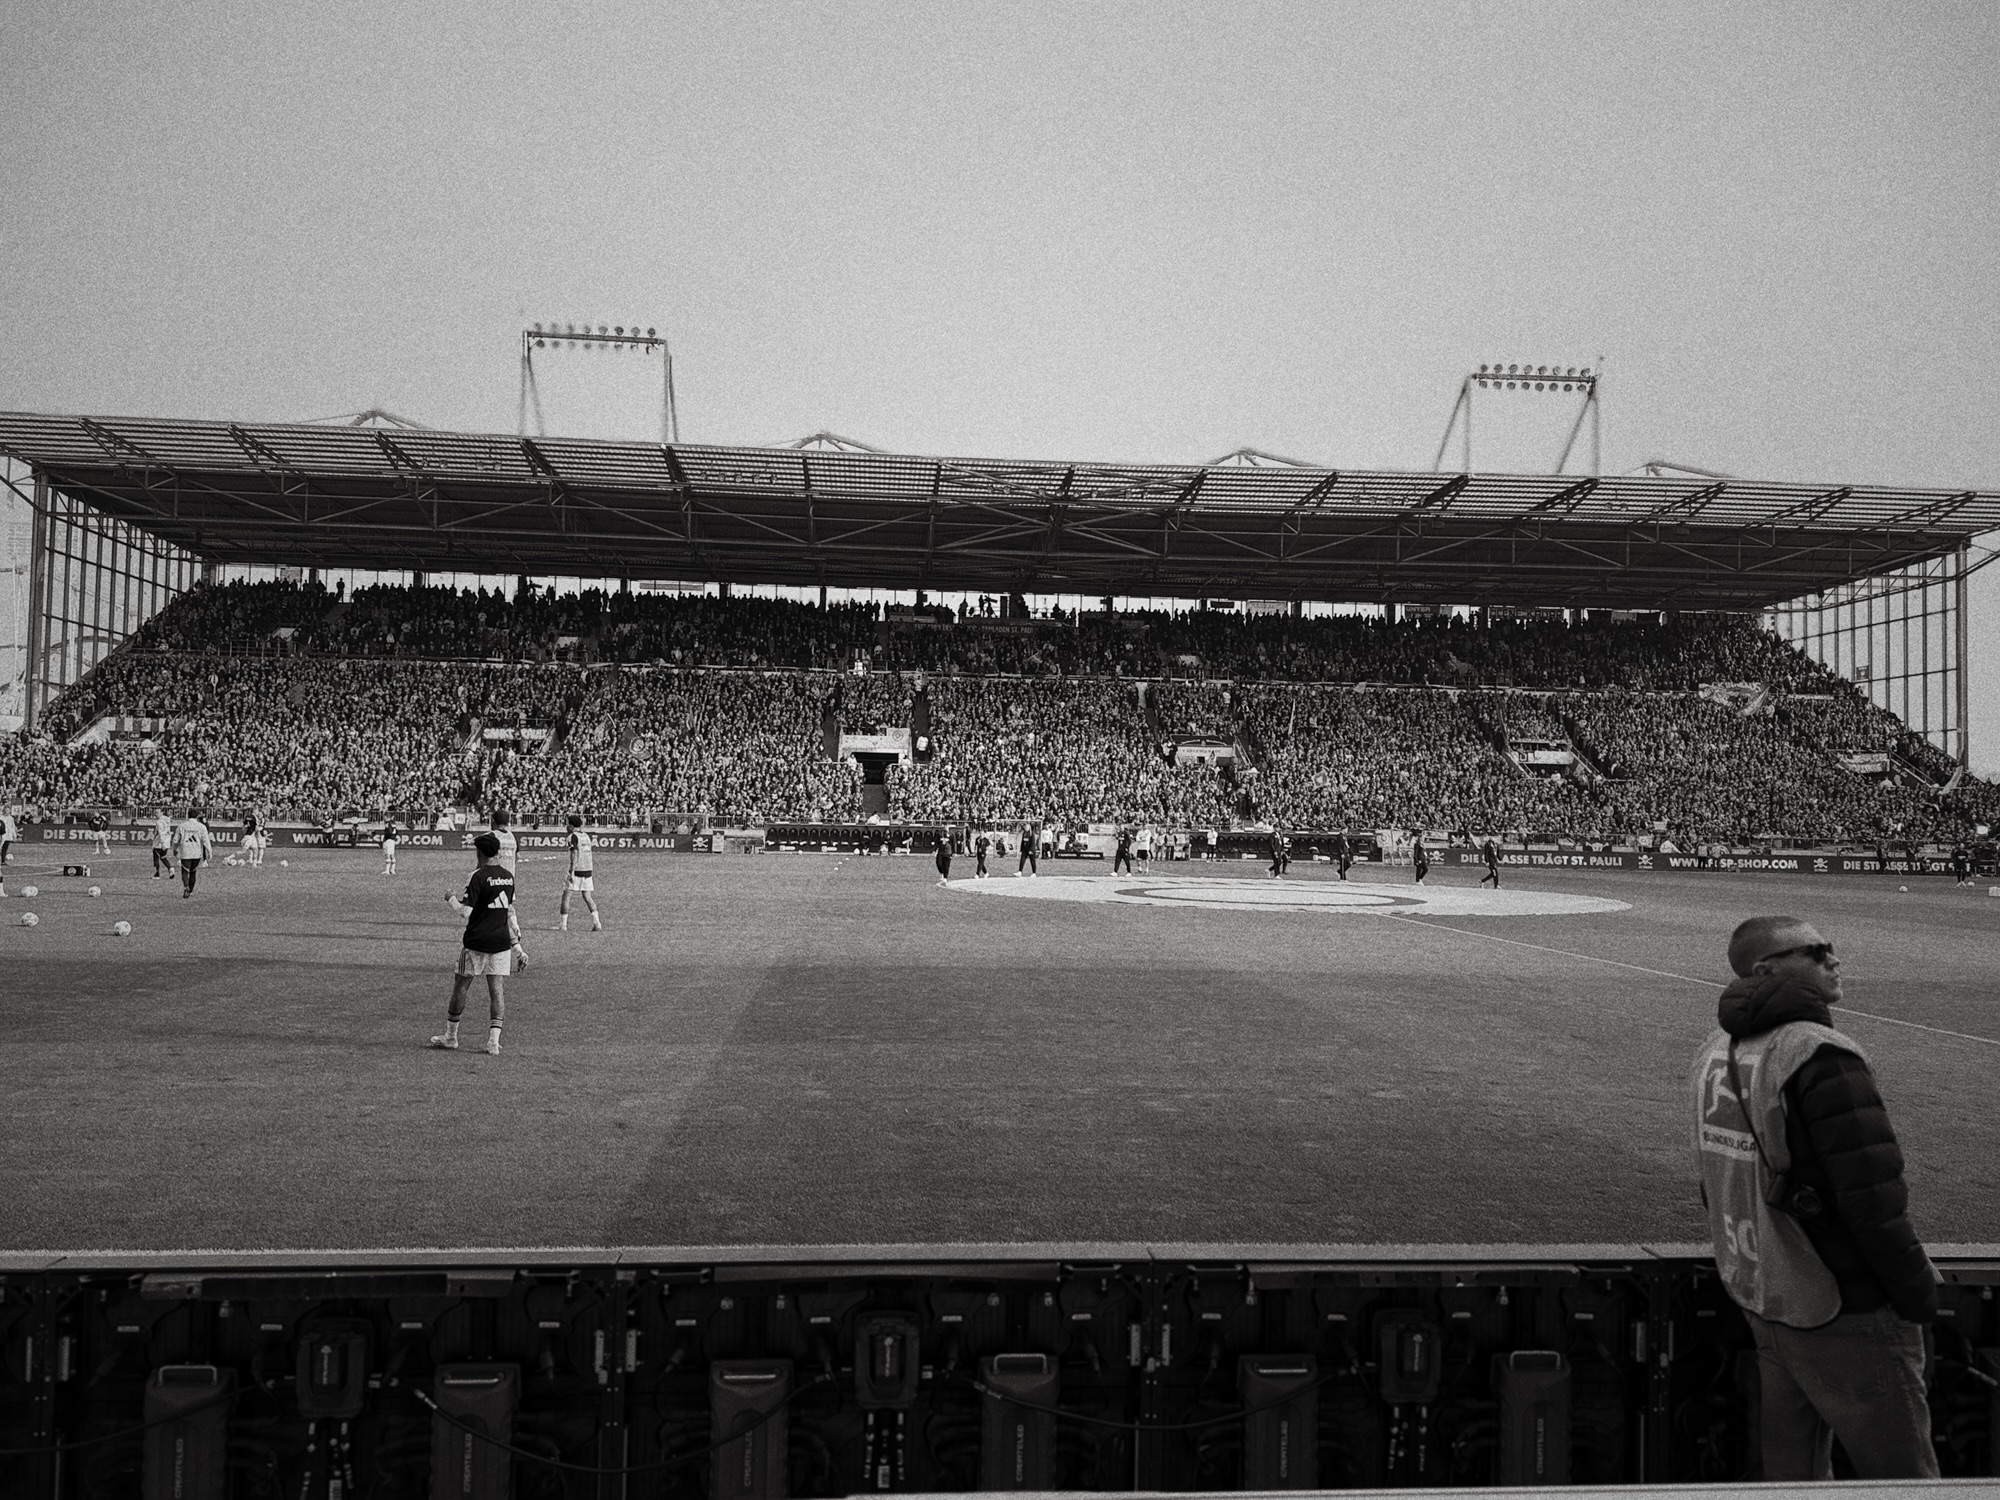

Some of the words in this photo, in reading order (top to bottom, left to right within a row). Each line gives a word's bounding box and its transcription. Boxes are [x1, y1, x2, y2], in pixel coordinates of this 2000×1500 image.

[43, 828, 66, 841] DIE
[618, 836, 636, 848] ST.
[638, 837, 675, 849] PAULI
[1460, 853, 1480, 863] DIE
[1531, 852, 1568, 866] TRÄGT
[1570, 855, 1587, 866] ST.
[1589, 856, 1622, 867] PAULI
[1843, 860, 1861, 870] DIE
